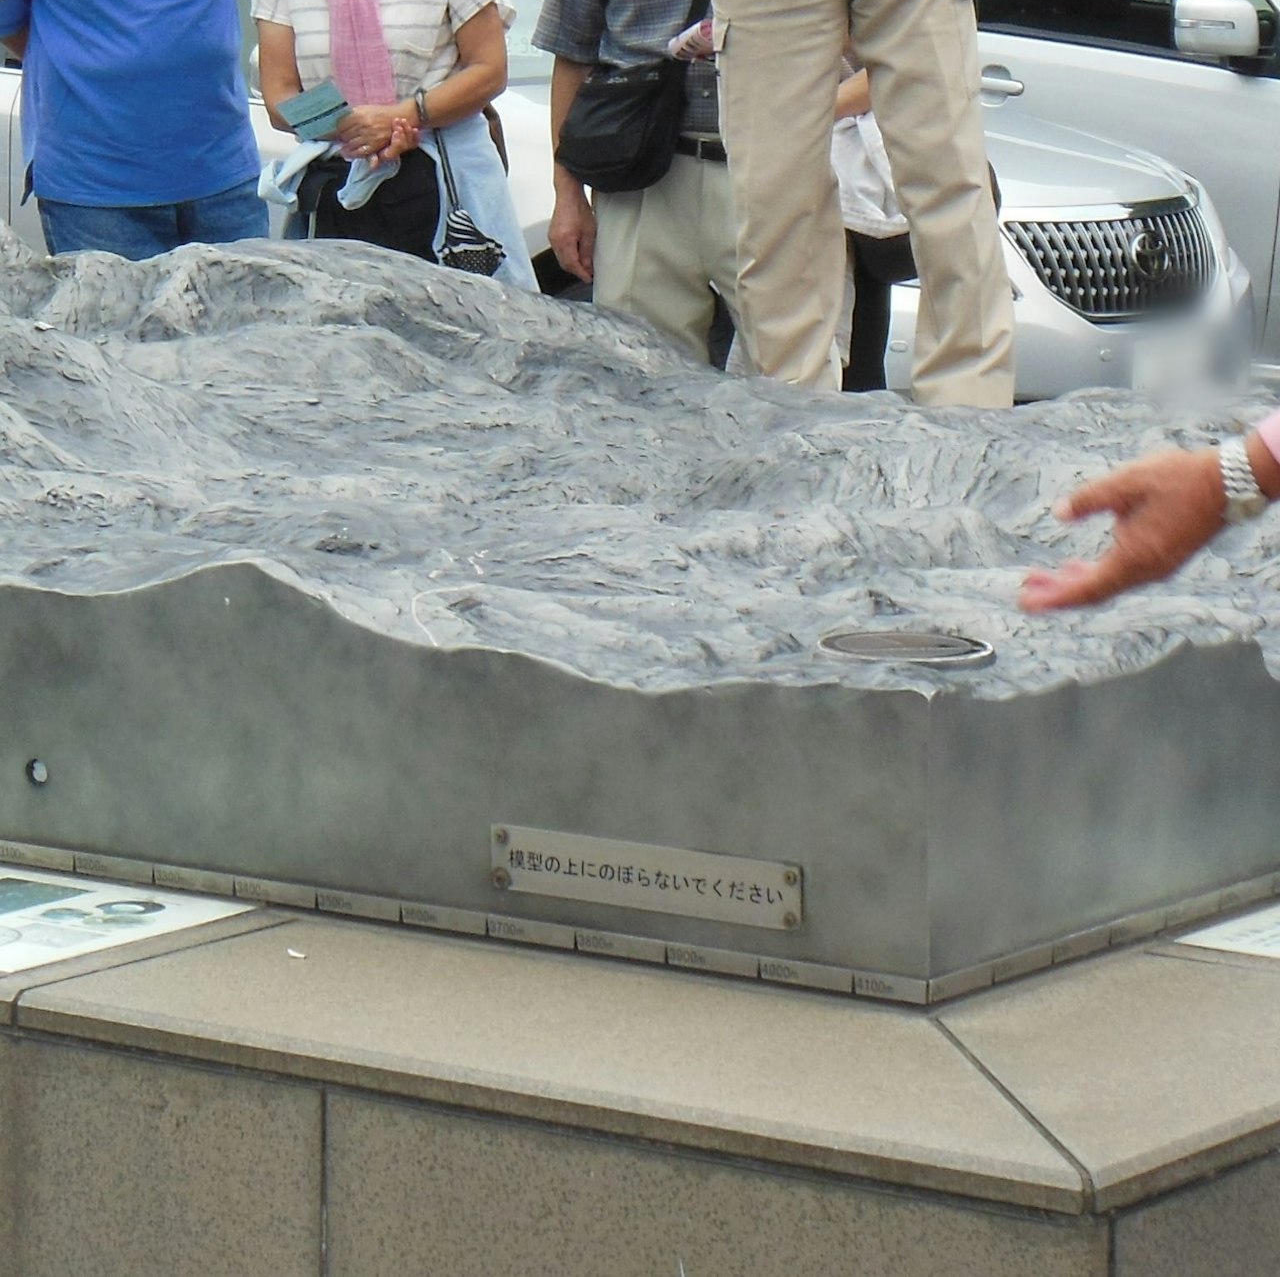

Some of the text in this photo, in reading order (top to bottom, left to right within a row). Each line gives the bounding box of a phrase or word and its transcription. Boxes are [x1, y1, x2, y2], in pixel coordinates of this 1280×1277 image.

[508, 848, 784, 906] 模型の上にのぼらないでください
[490, 919, 524, 936] 3700m
[578, 933, 613, 950] 3800m
[669, 947, 705, 965] 3900m
[762, 961, 798, 979] 4000m
[857, 977, 893, 995] 4100m
